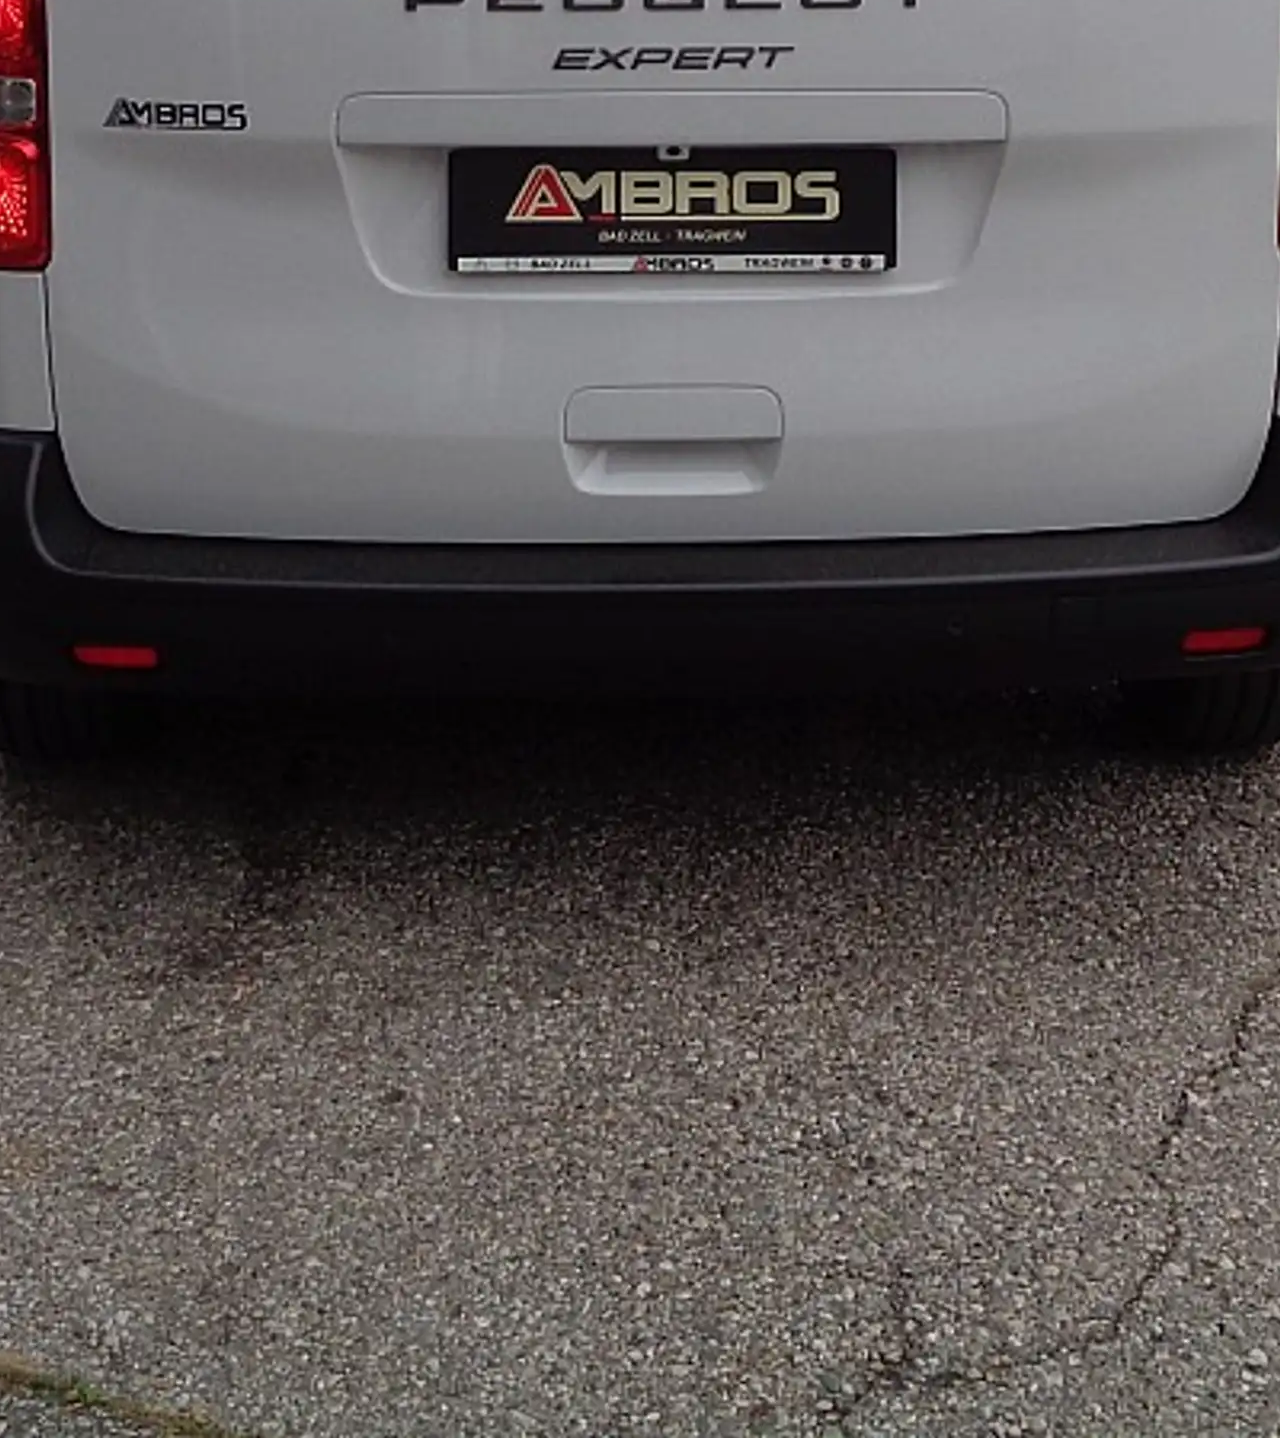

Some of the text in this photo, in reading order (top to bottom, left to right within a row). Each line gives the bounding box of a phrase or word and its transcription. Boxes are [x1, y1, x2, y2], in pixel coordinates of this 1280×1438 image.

[552, 47, 795, 71] EXPERT
[102, 97, 248, 130] AMBROS
[505, 164, 841, 222] AMBROS
